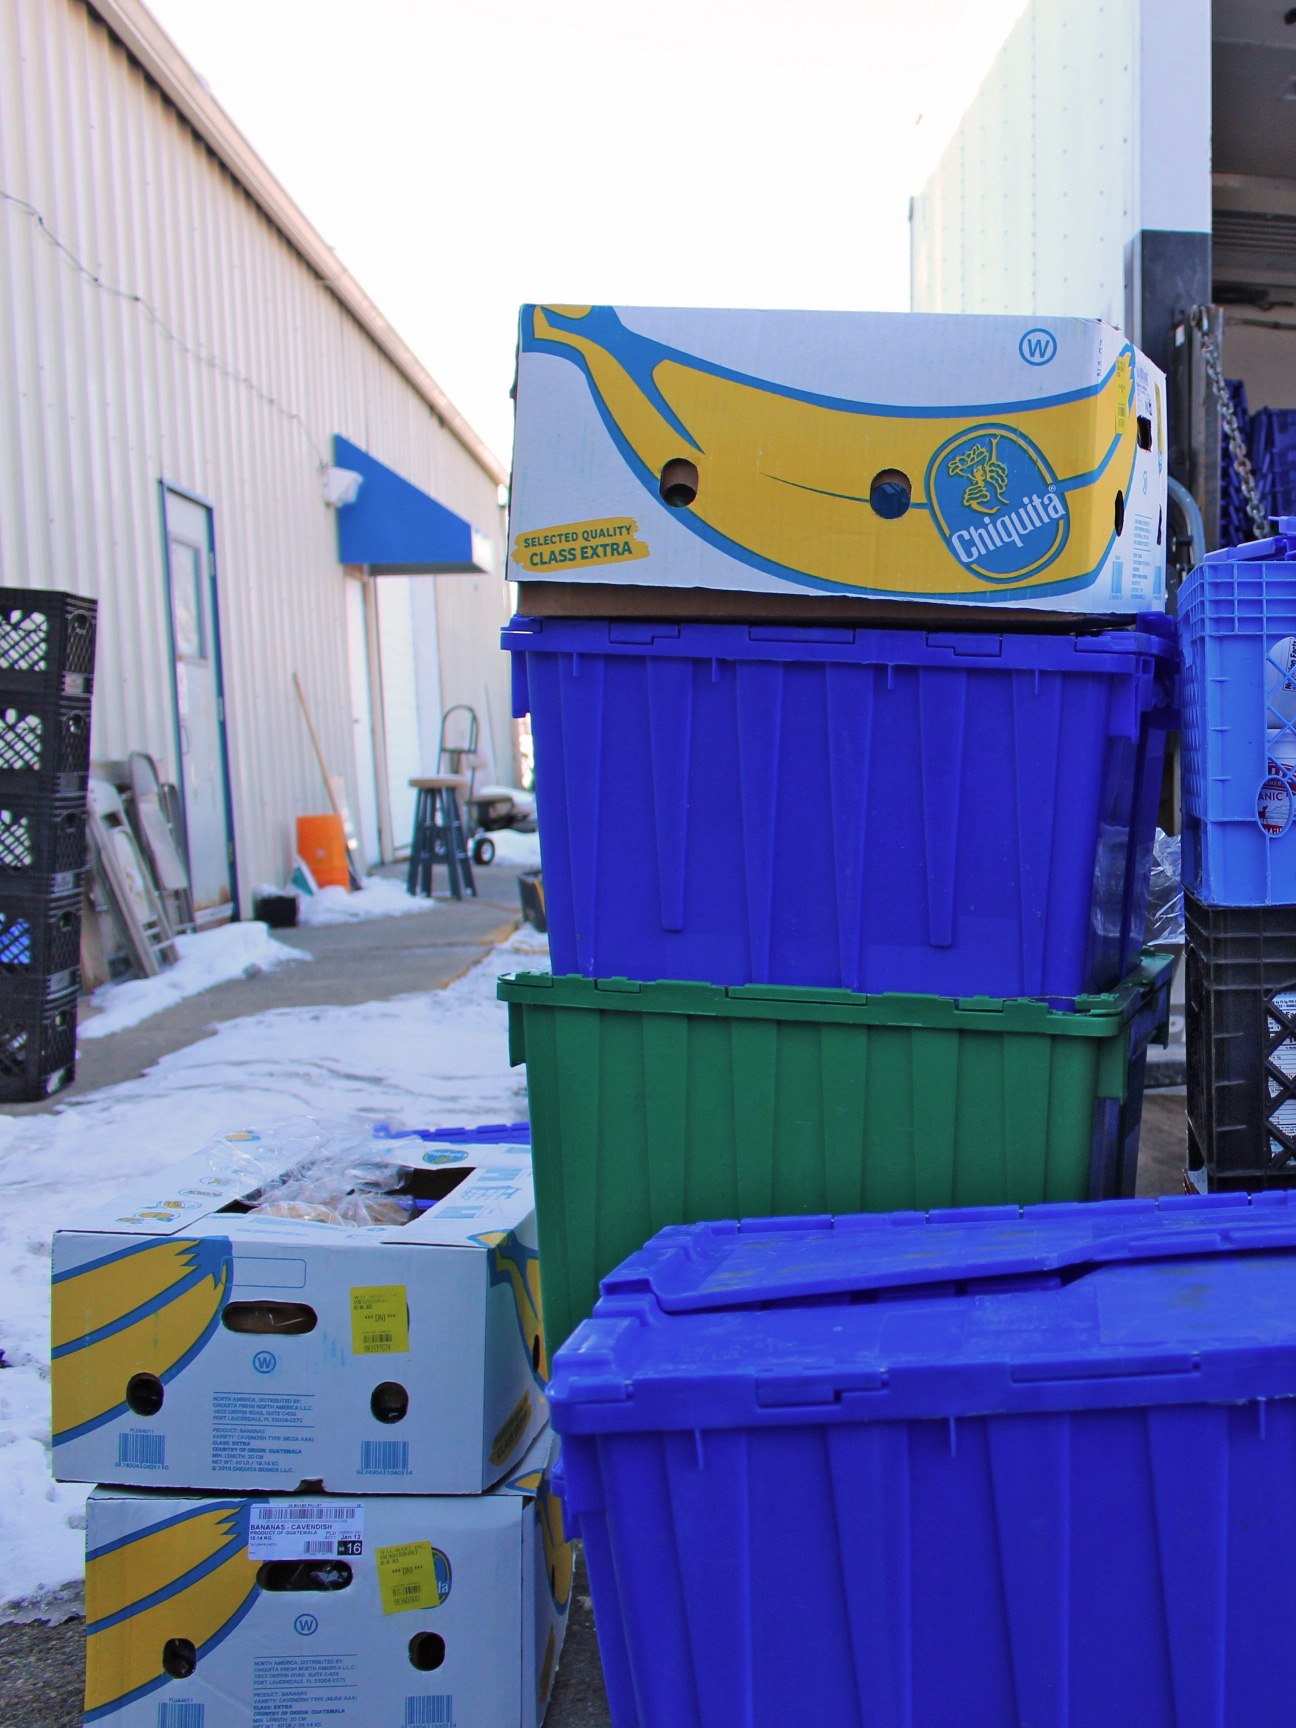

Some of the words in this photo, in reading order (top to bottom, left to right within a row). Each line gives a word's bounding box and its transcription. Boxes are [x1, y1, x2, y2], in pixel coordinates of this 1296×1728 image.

[1027, 338, 1050, 358] W
[523, 531, 579, 548] SELECTED
[581, 525, 632, 541] QUALITY
[951, 492, 1066, 563] Chiquita
[529, 547, 577, 566] CLASS
[580, 541, 633, 560] EXTRA
[258, 1357, 272, 1369] W
[347, 1543, 361, 1554] 16
[299, 1620, 313, 1631] W
